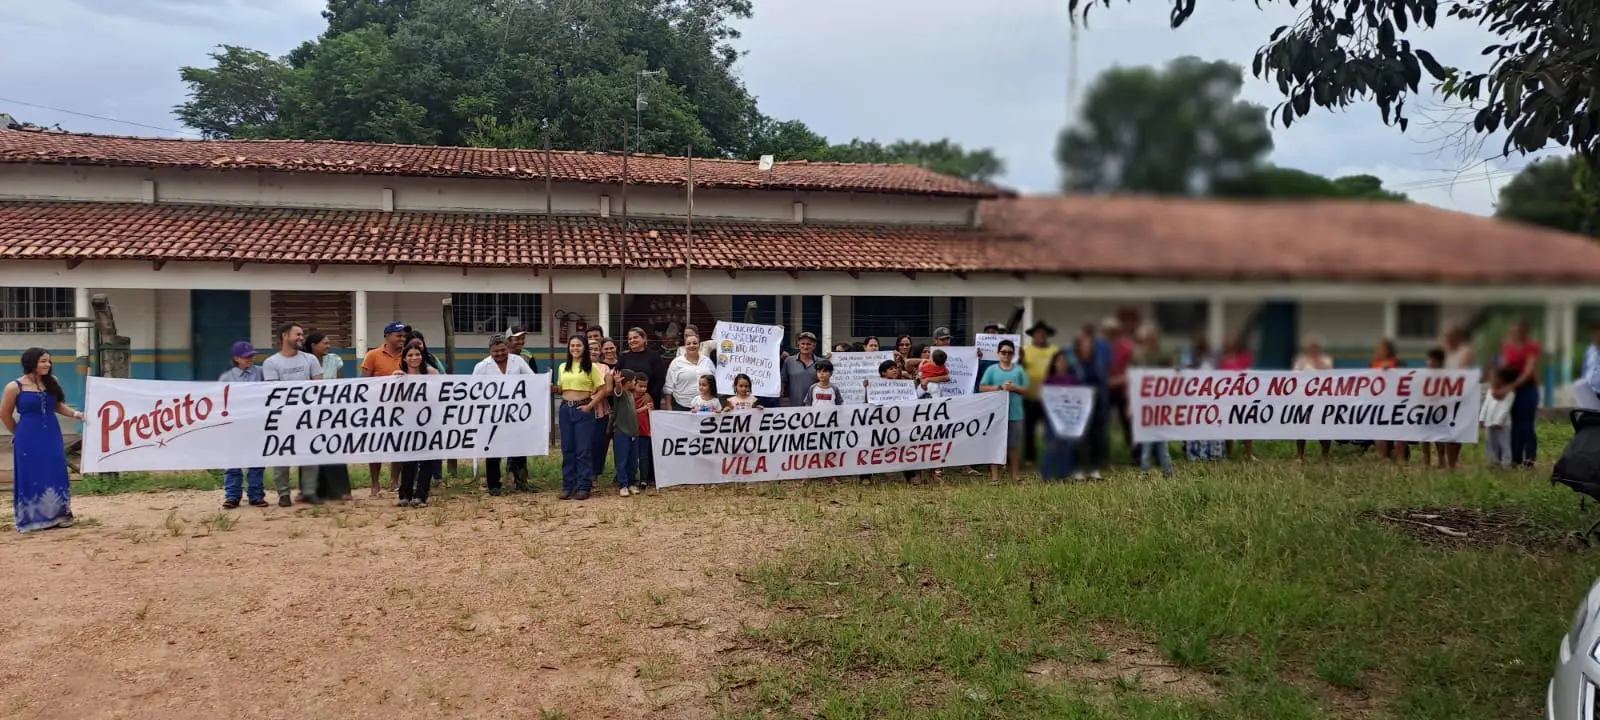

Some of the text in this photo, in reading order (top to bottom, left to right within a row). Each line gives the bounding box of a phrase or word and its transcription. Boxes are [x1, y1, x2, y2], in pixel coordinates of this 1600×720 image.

[265, 380, 527, 406] FECHAR UMA ESCOLA
[1140, 371, 1466, 401] EDUCAÇÃO NO CAMPO É UM
[264, 403, 531, 431] É APAGAR O FUTURO
[699, 398, 953, 434] SEM ESCOLA NÃO HÁ
[1141, 398, 1462, 427] DIREITO, NÃO UM PRIVILÉGIO!
[263, 434, 296, 456] DA
[662, 430, 858, 457] DESENVOLVIMENTO
[870, 427, 900, 447] NO
[721, 442, 953, 475] VILA JUARI RESISTE!
